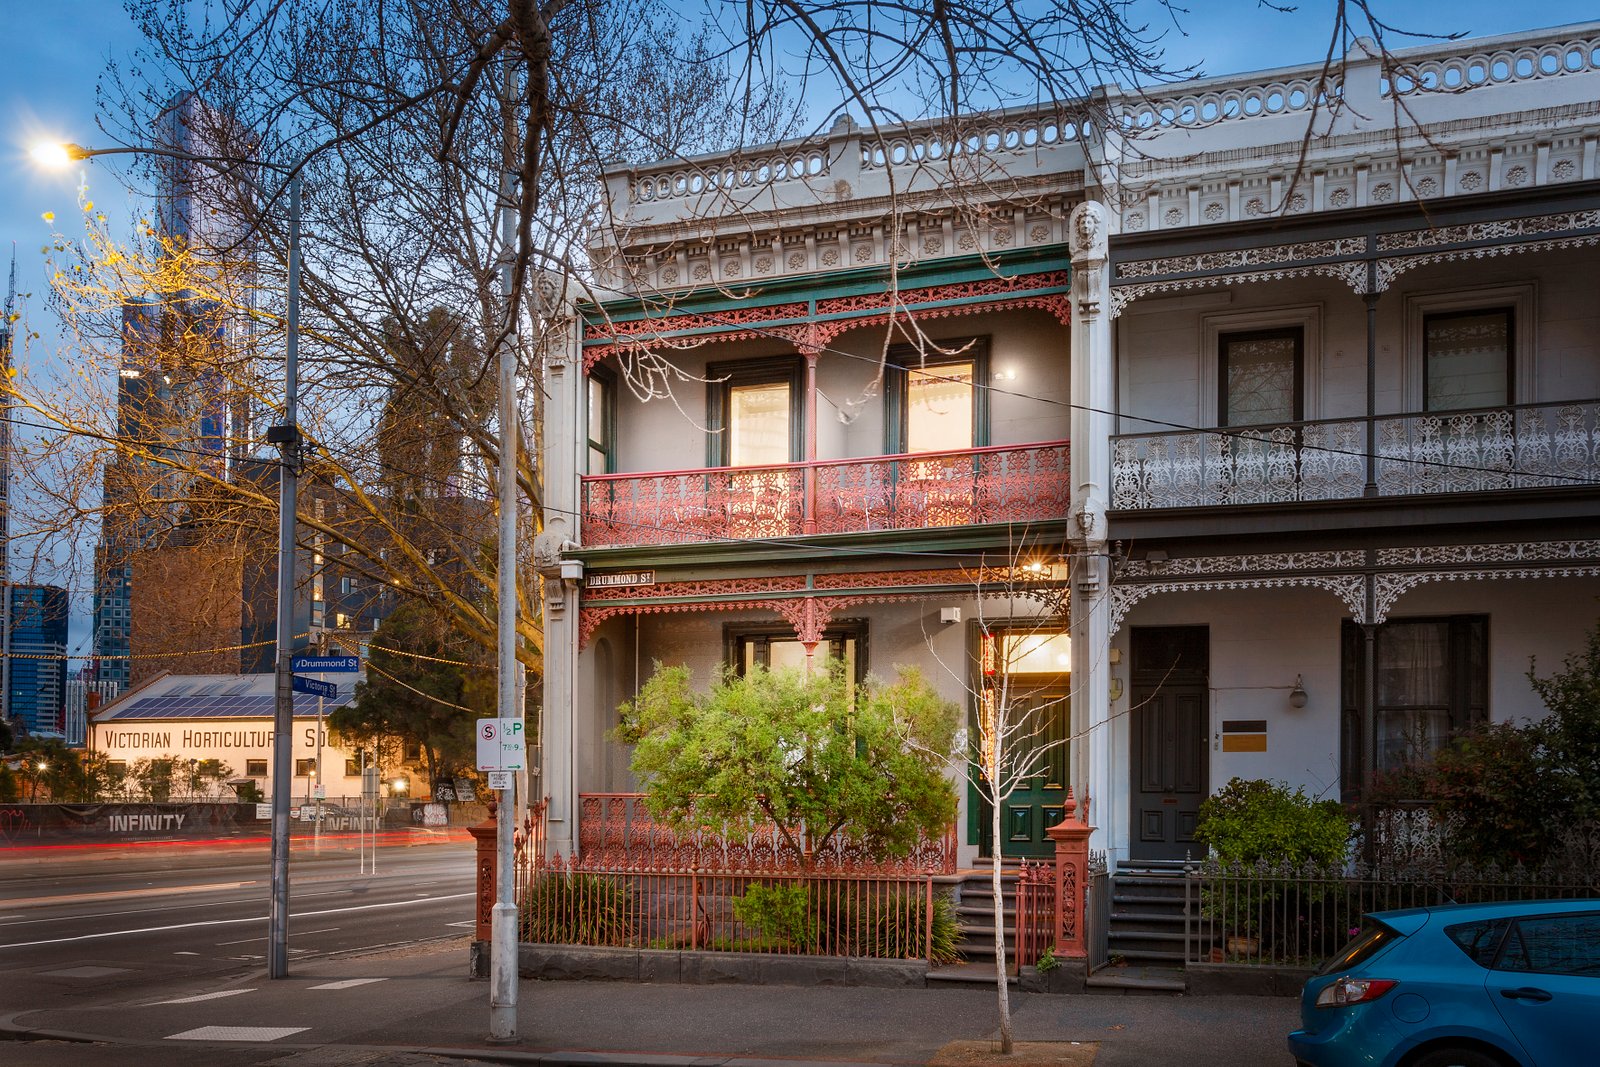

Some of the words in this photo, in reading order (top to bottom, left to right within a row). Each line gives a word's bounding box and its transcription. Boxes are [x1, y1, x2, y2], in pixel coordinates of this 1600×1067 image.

[590, 574, 637, 585] DRUMMOND
[301, 659, 345, 667] Drummond
[348, 658, 357, 667] St
[305, 680, 328, 691] Victoria
[329, 684, 335, 693] St
[105, 731, 171, 748] VICTORIAN
[183, 729, 276, 748] HORTICULTUR
[109, 814, 185, 831] INFINITY
